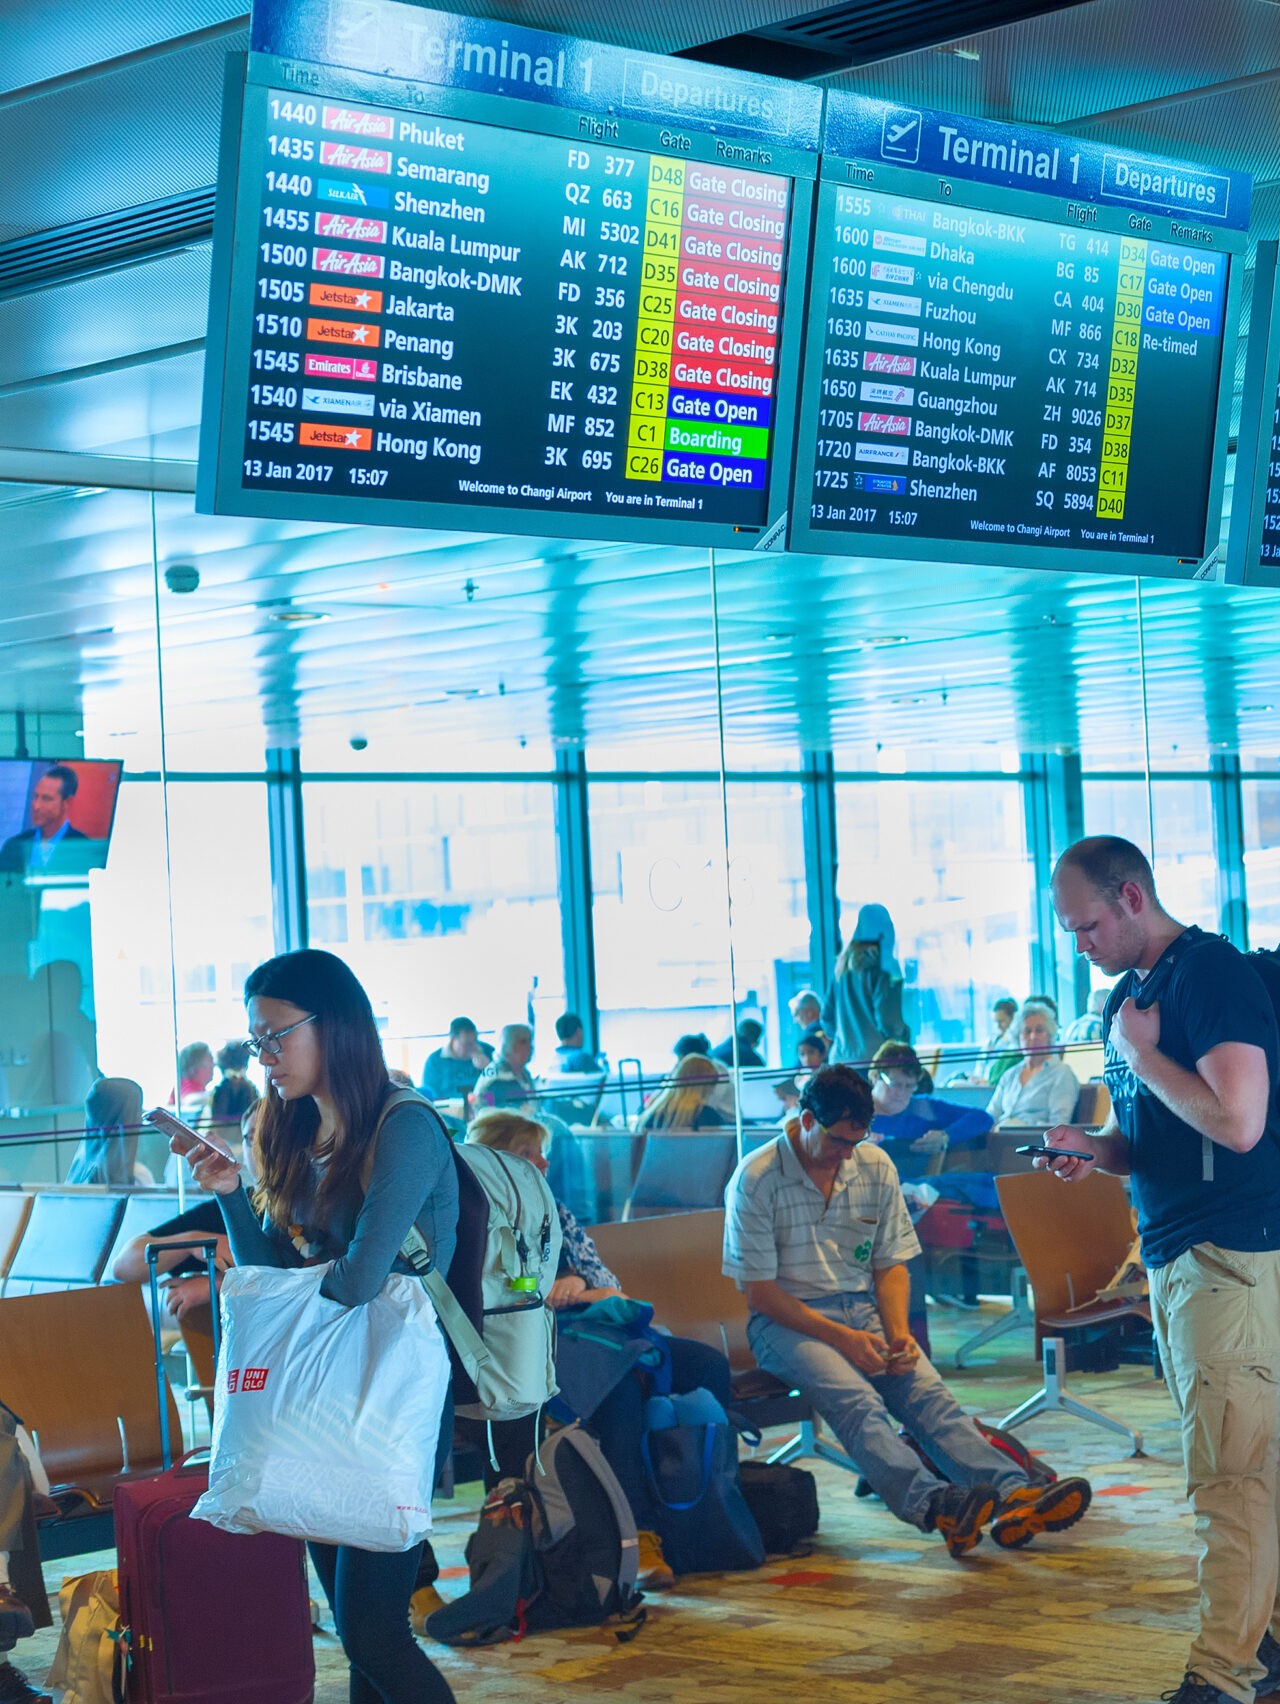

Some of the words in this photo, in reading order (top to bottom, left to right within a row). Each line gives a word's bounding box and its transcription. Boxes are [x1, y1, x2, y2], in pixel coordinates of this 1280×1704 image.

[404, 19, 567, 91] Terminal
[574, 53, 598, 97] 1
[638, 67, 776, 125] Departures
[279, 60, 319, 90] Time
[405, 84, 425, 111] To
[578, 116, 617, 140] Flight
[660, 131, 690, 151] Gate
[716, 141, 770, 165] Remarks
[271, 99, 317, 125] 1440
[399, 121, 464, 151] Phuket
[568, 149, 590, 170] FD
[604, 155, 635, 177] 377
[651, 165, 682, 186] D48
[689, 168, 728, 194] Gate
[727, 174, 788, 210] Closing
[938, 125, 1059, 180] Terminal
[1069, 152, 1080, 184] 1
[1115, 160, 1215, 203] Departures
[845, 163, 873, 182] Time
[938, 180, 951, 196] To
[1067, 204, 1096, 224] Flight
[1128, 215, 1151, 232] Gate
[1170, 222, 1212, 243] Remarks
[263, 206, 309, 231] 1455
[392, 226, 445, 251] Kuala
[450, 234, 520, 263] Lumpur
[560, 249, 586, 270] AK
[598, 253, 627, 276] 712
[644, 262, 675, 282] D35
[682, 267, 719, 289] Gate
[723, 273, 779, 302] Closing
[258, 278, 304, 302] 1505
[385, 295, 454, 321] Jakarta
[555, 314, 578, 335] 3K
[592, 319, 622, 340] 203
[640, 327, 669, 346] C20
[677, 331, 714, 353] Gate
[718, 336, 775, 365] Closing
[830, 287, 863, 307] 1635
[925, 301, 976, 324] Fuzhou
[1051, 319, 1071, 336] MF
[1079, 323, 1101, 340] 866
[1114, 330, 1137, 347] C18
[1143, 333, 1197, 355] Re-timed
[253, 349, 299, 372] 1545
[308, 358, 351, 374] Emirates
[382, 363, 462, 390] Brisbane
[550, 380, 573, 400] EK
[587, 385, 617, 405] 432
[635, 391, 664, 410] C13
[672, 395, 710, 416] Gate
[714, 399, 757, 423] Open
[822, 378, 856, 398] 1650
[917, 391, 997, 416] Guangzhou
[1043, 404, 1061, 421] ZH
[1071, 408, 1101, 426] 9026
[1106, 413, 1130, 430] D37
[825, 348, 858, 368] 1635
[920, 361, 959, 381] Kuala
[963, 366, 1016, 390] Lumpur
[1045, 376, 1065, 393] AK
[1074, 379, 1096, 397] 714
[1109, 385, 1133, 402] D35
[251, 384, 297, 407] 1540
[379, 398, 407, 419] via
[411, 401, 481, 426] Xiamen
[547, 413, 575, 433] MF
[584, 417, 614, 437] 852
[637, 424, 655, 442] C1
[670, 427, 742, 455] Boarding
[244, 460, 261, 476] 13
[265, 461, 291, 478] Jan
[296, 463, 333, 481] 2017
[349, 468, 388, 485] 15:07
[458, 480, 504, 494] Welcome
[507, 484, 518, 495] to
[520, 484, 554, 500] Changi
[556, 487, 592, 502] Airport
[817, 439, 851, 458] 1720
[912, 450, 1005, 474] Bangkok-BKK
[1038, 462, 1056, 478] AF
[1066, 464, 1096, 482] 8053
[1102, 469, 1123, 486] C11
[605, 491, 624, 503] You
[626, 495, 642, 505] are
[643, 494, 653, 505] in
[655, 495, 695, 509] Terminal
[697, 499, 703, 509] 1
[244, 1380, 263, 1389] QLO
[245, 1371, 265, 1380] UNI
